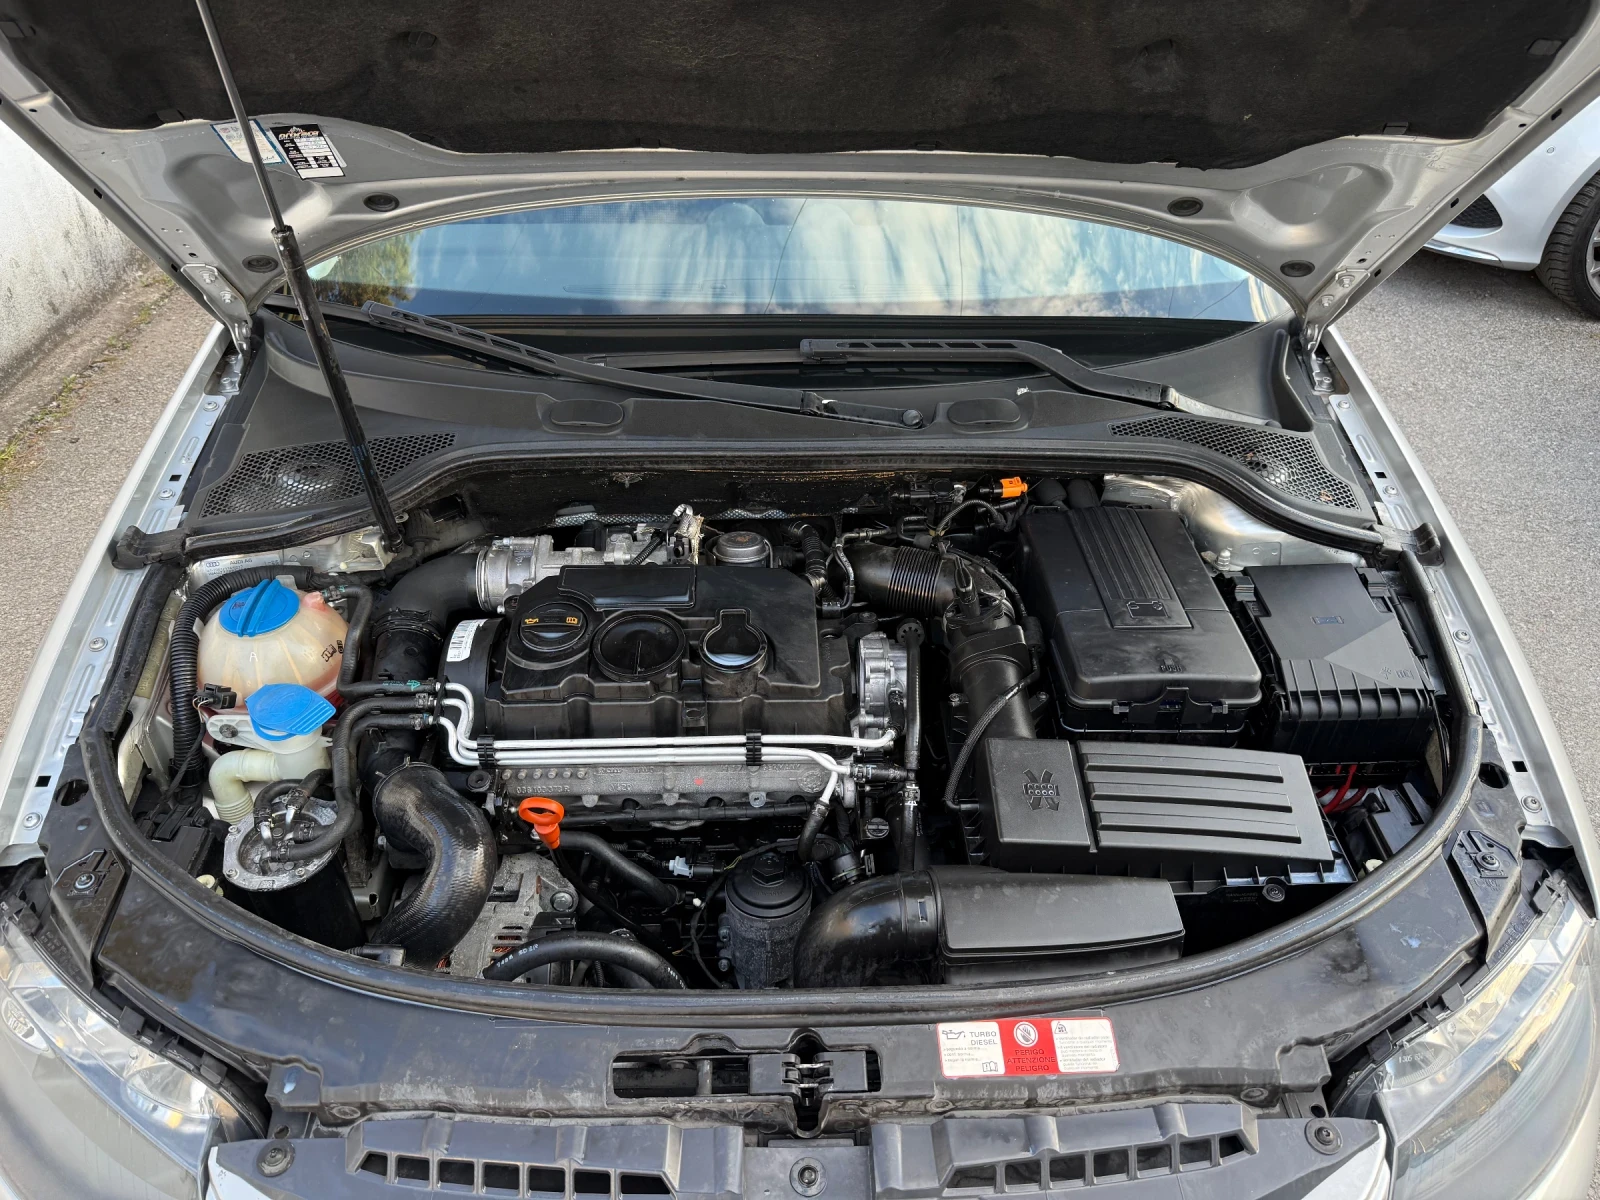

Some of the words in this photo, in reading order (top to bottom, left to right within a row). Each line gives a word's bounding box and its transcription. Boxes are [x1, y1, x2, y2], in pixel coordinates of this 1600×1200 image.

[969, 1030, 997, 1038] TURBO
[1014, 1048, 1045, 1056] PERIGO
[1007, 1056, 1056, 1064] ATTENZIONE
[1015, 1064, 1050, 1072] PELIGRO
